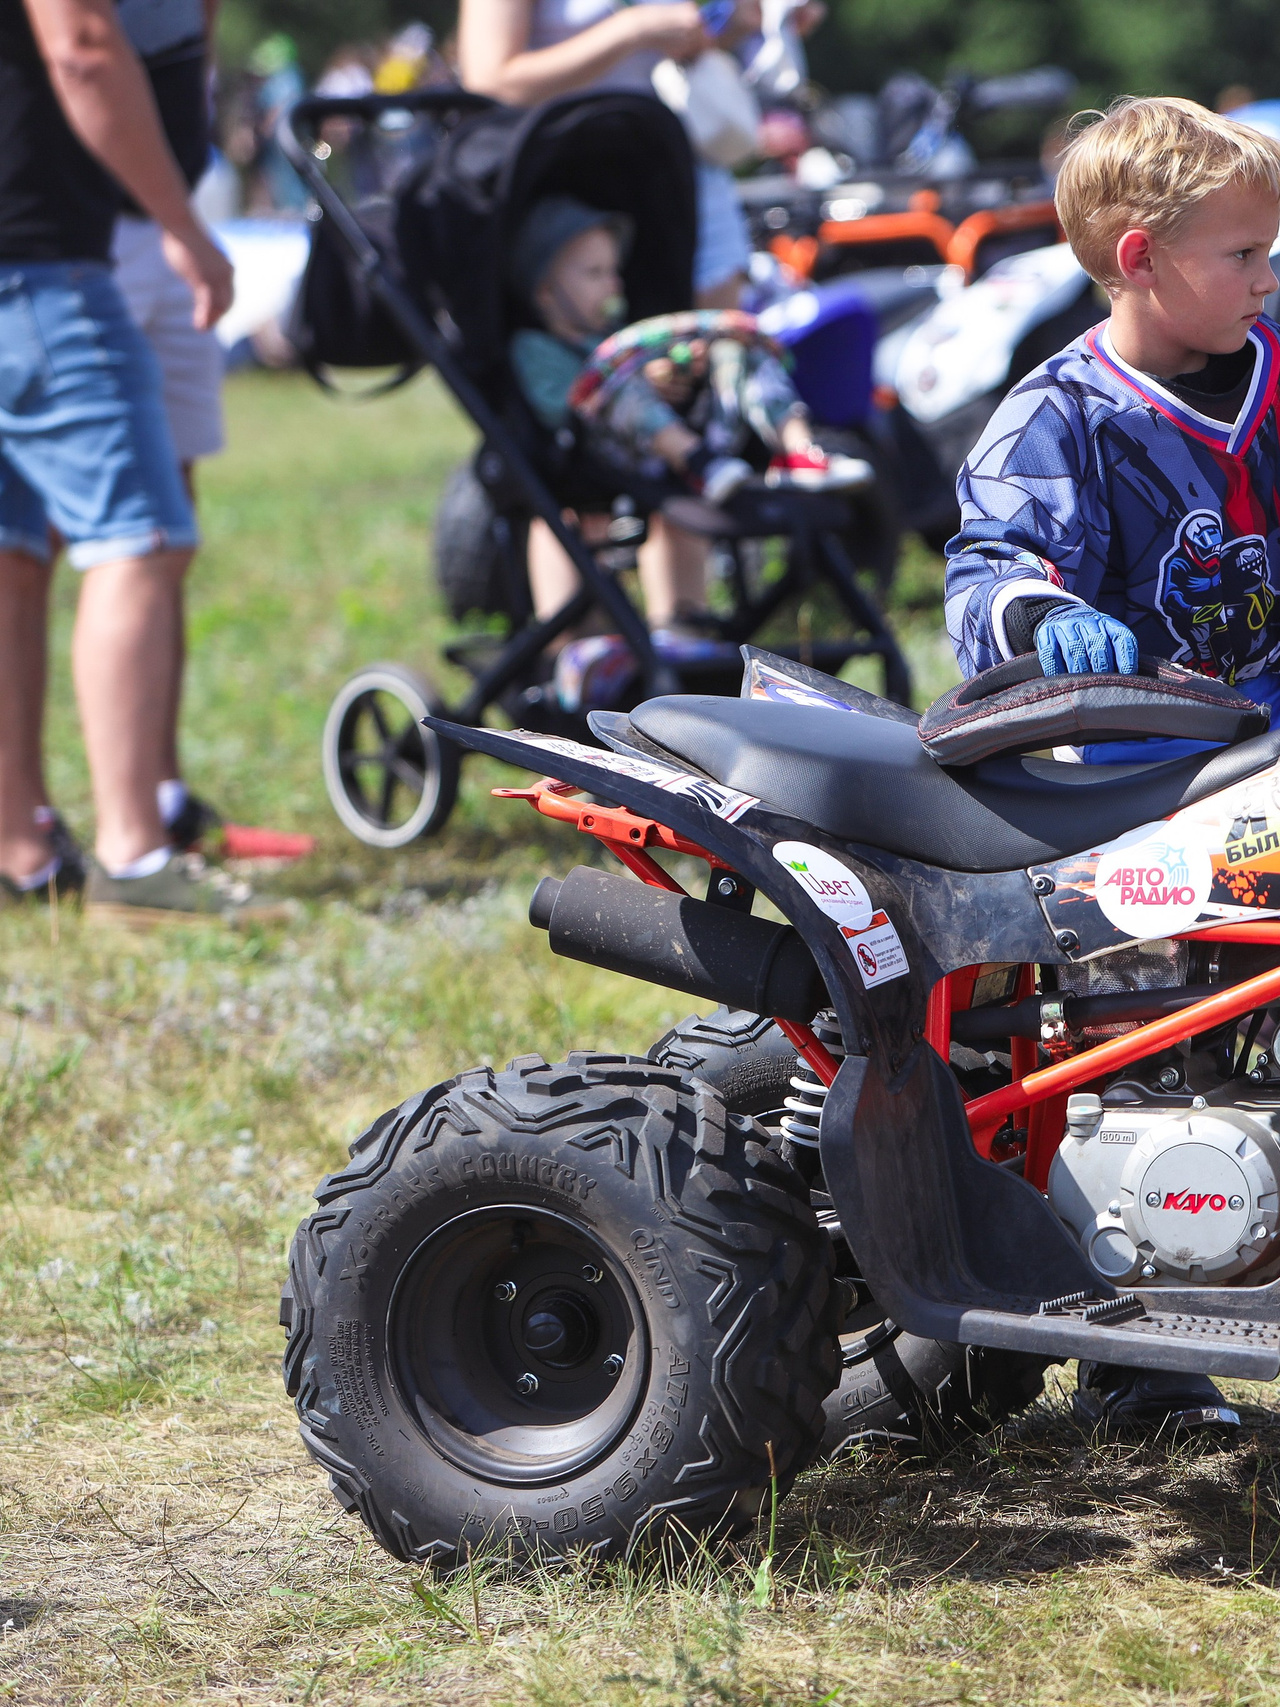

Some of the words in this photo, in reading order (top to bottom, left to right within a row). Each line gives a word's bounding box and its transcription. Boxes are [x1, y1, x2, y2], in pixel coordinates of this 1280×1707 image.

[1226, 831, 1280, 864] БЫЛ
[1104, 867, 1165, 886] АВТО
[1120, 886, 1195, 905] РАДИО
[456, 1152, 597, 1201] COUNTRY
[1162, 1186, 1227, 1214] KAYO
